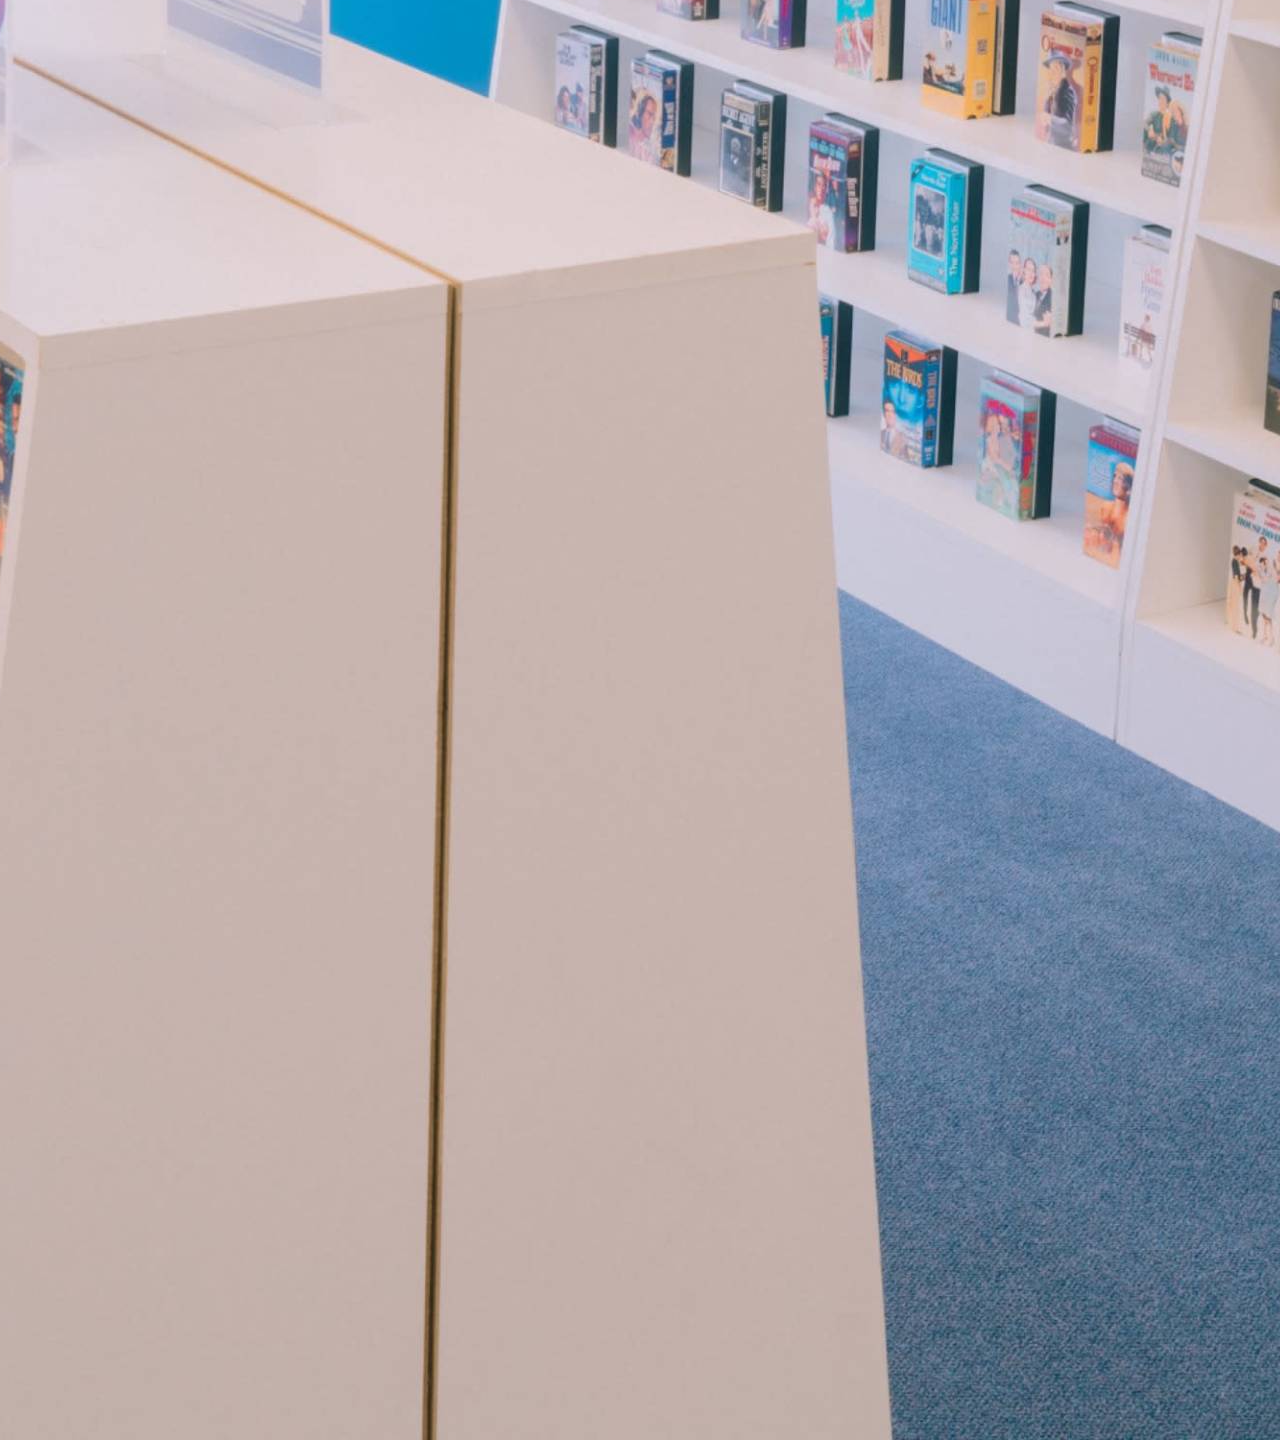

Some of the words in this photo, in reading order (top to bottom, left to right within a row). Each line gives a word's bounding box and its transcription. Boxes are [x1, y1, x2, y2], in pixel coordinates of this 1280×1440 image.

[951, 223, 962, 256] North
[886, 358, 904, 379] THE
[903, 364, 923, 389] BIRDS
